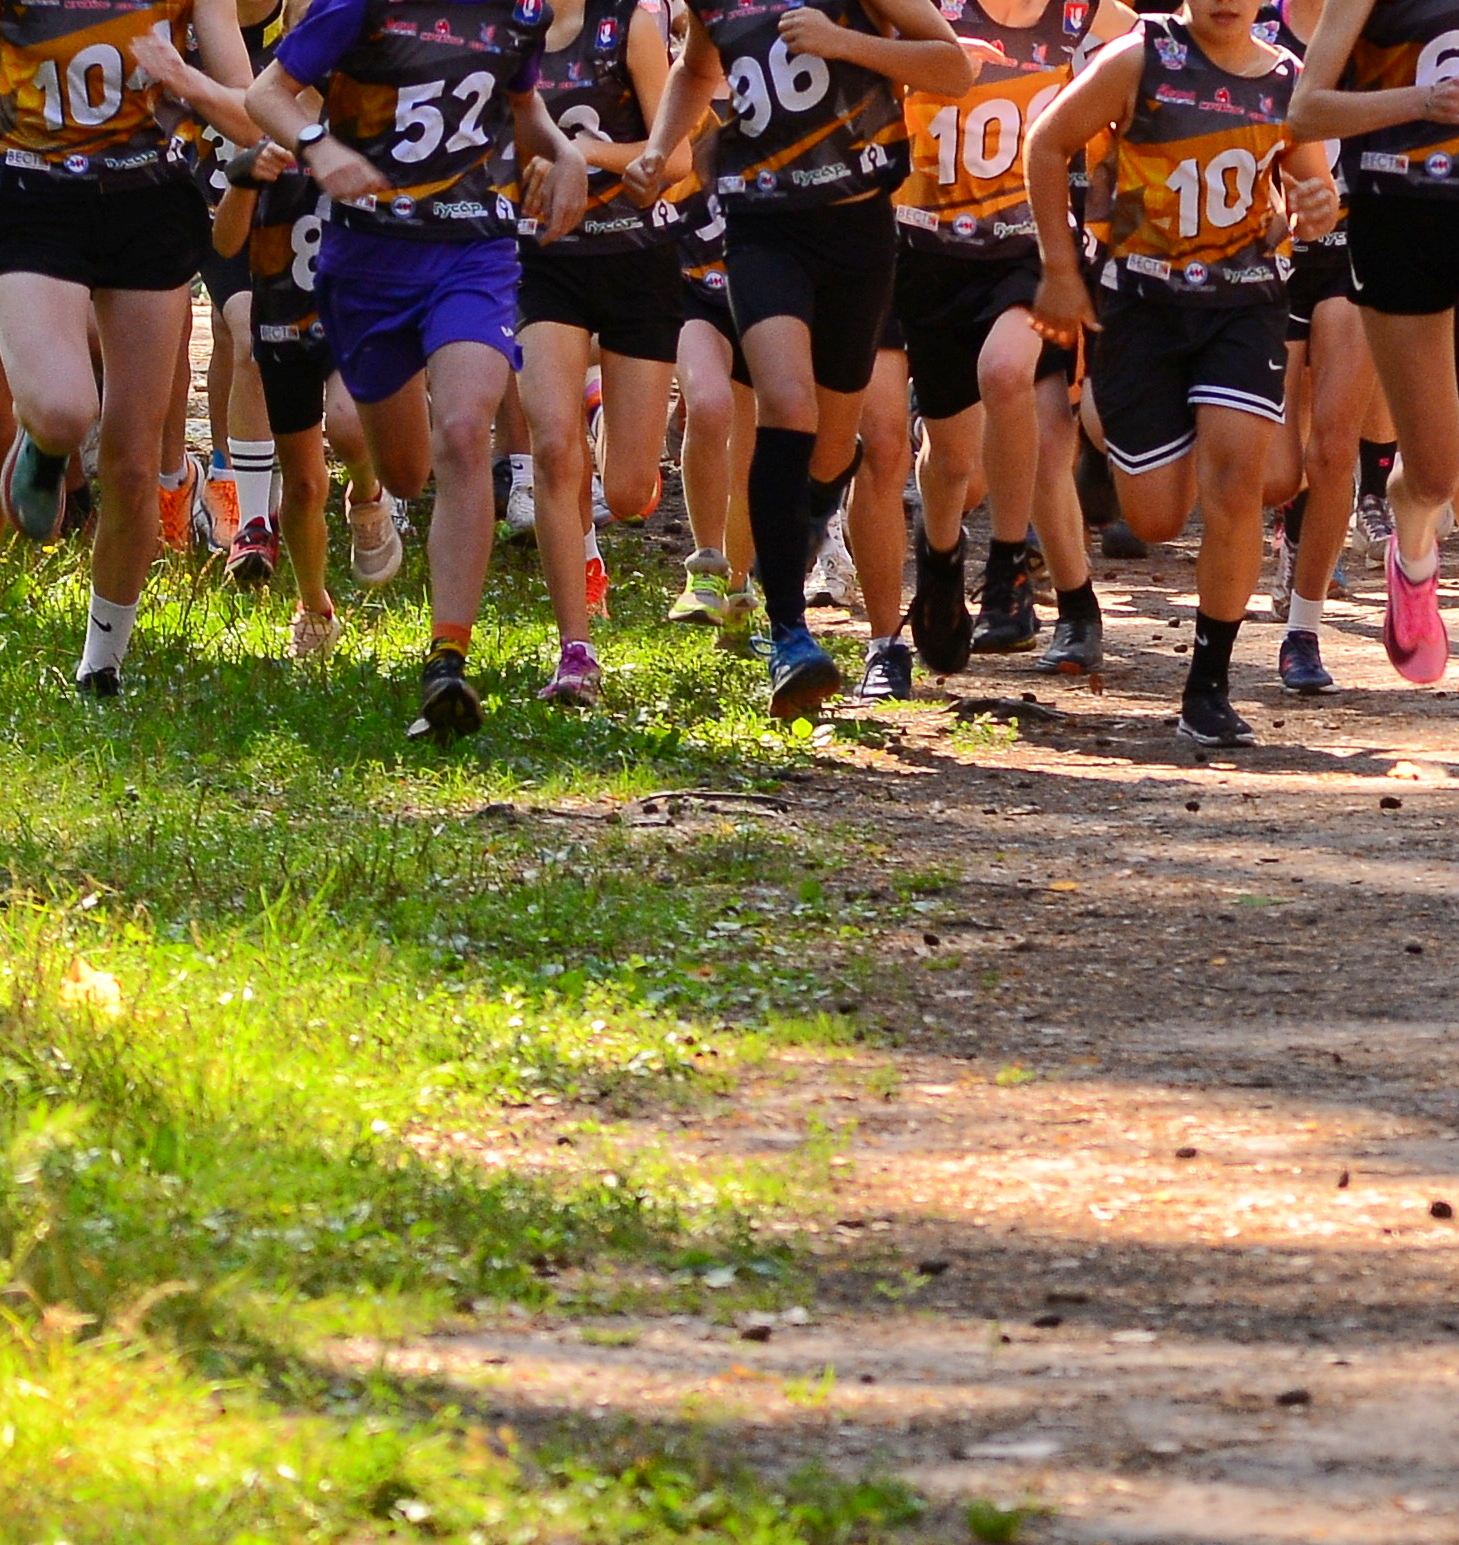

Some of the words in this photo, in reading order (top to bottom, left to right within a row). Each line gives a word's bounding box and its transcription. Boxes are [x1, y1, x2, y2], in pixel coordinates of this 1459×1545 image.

[391, 70, 496, 164] 52
[727, 35, 831, 138] 96
[1165, 140, 1286, 238] 10
